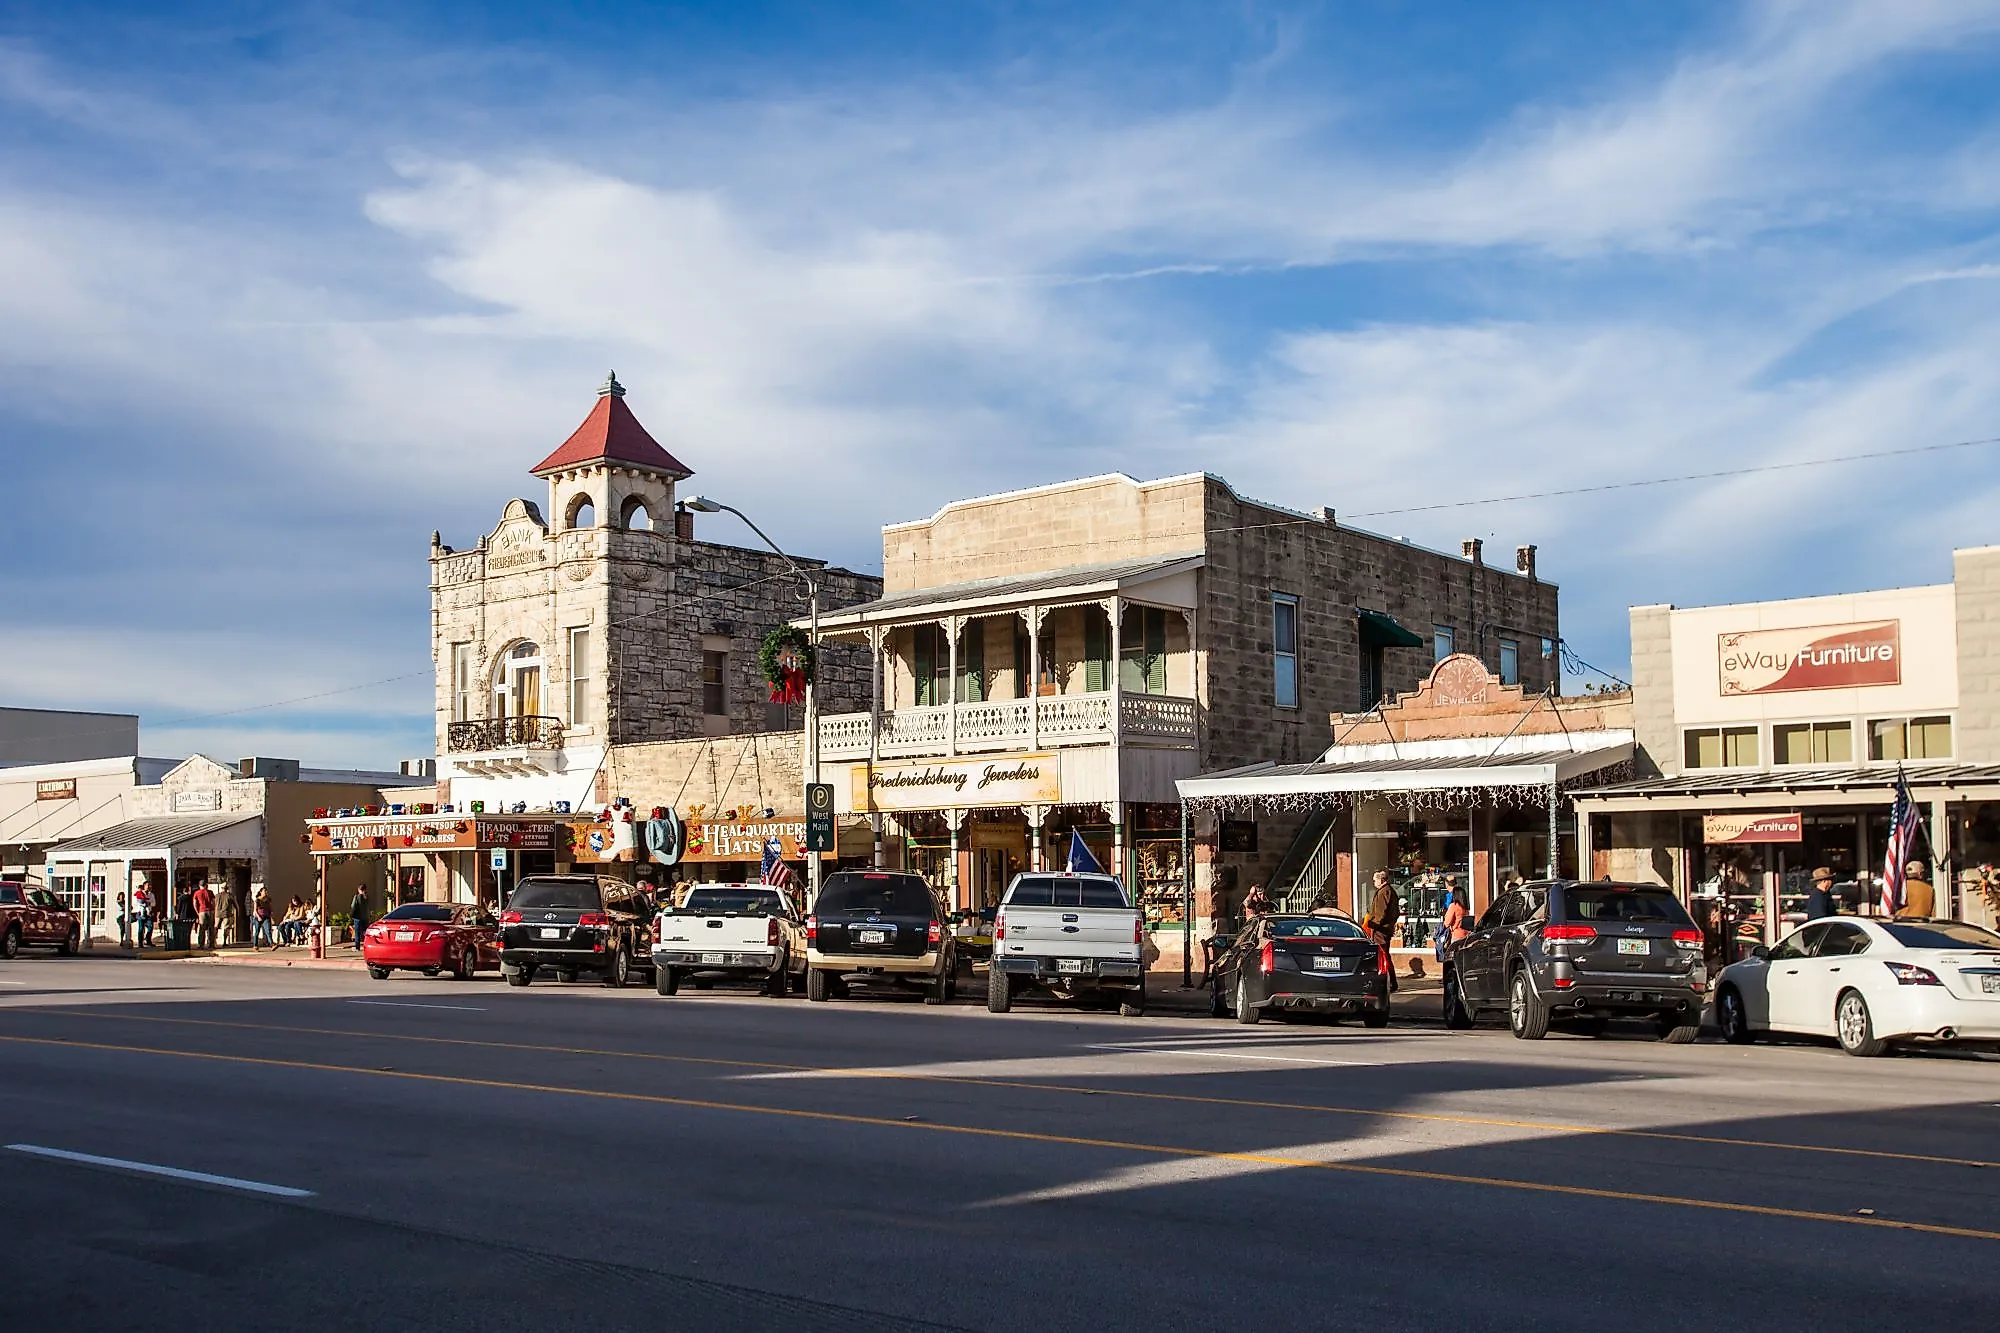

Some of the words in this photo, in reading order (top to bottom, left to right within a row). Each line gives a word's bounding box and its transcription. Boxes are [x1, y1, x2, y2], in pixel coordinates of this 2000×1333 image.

[501, 529, 534, 550] BANK
[1724, 650, 1788, 671] eWay
[1798, 643, 1893, 667] Furniture
[1435, 687, 1486, 706] JEWELER
[867, 766, 968, 792] Fredericksburg
[977, 761, 1040, 789] Jewelers
[816, 790, 824, 804] P
[812, 811, 829, 820] West
[329, 822, 413, 841] HEADQUARTERS
[812, 822, 829, 832] Main
[1706, 823, 1742, 834] eWay
[1746, 822, 1798, 832] Furniture
[713, 837, 762, 856] HATS
